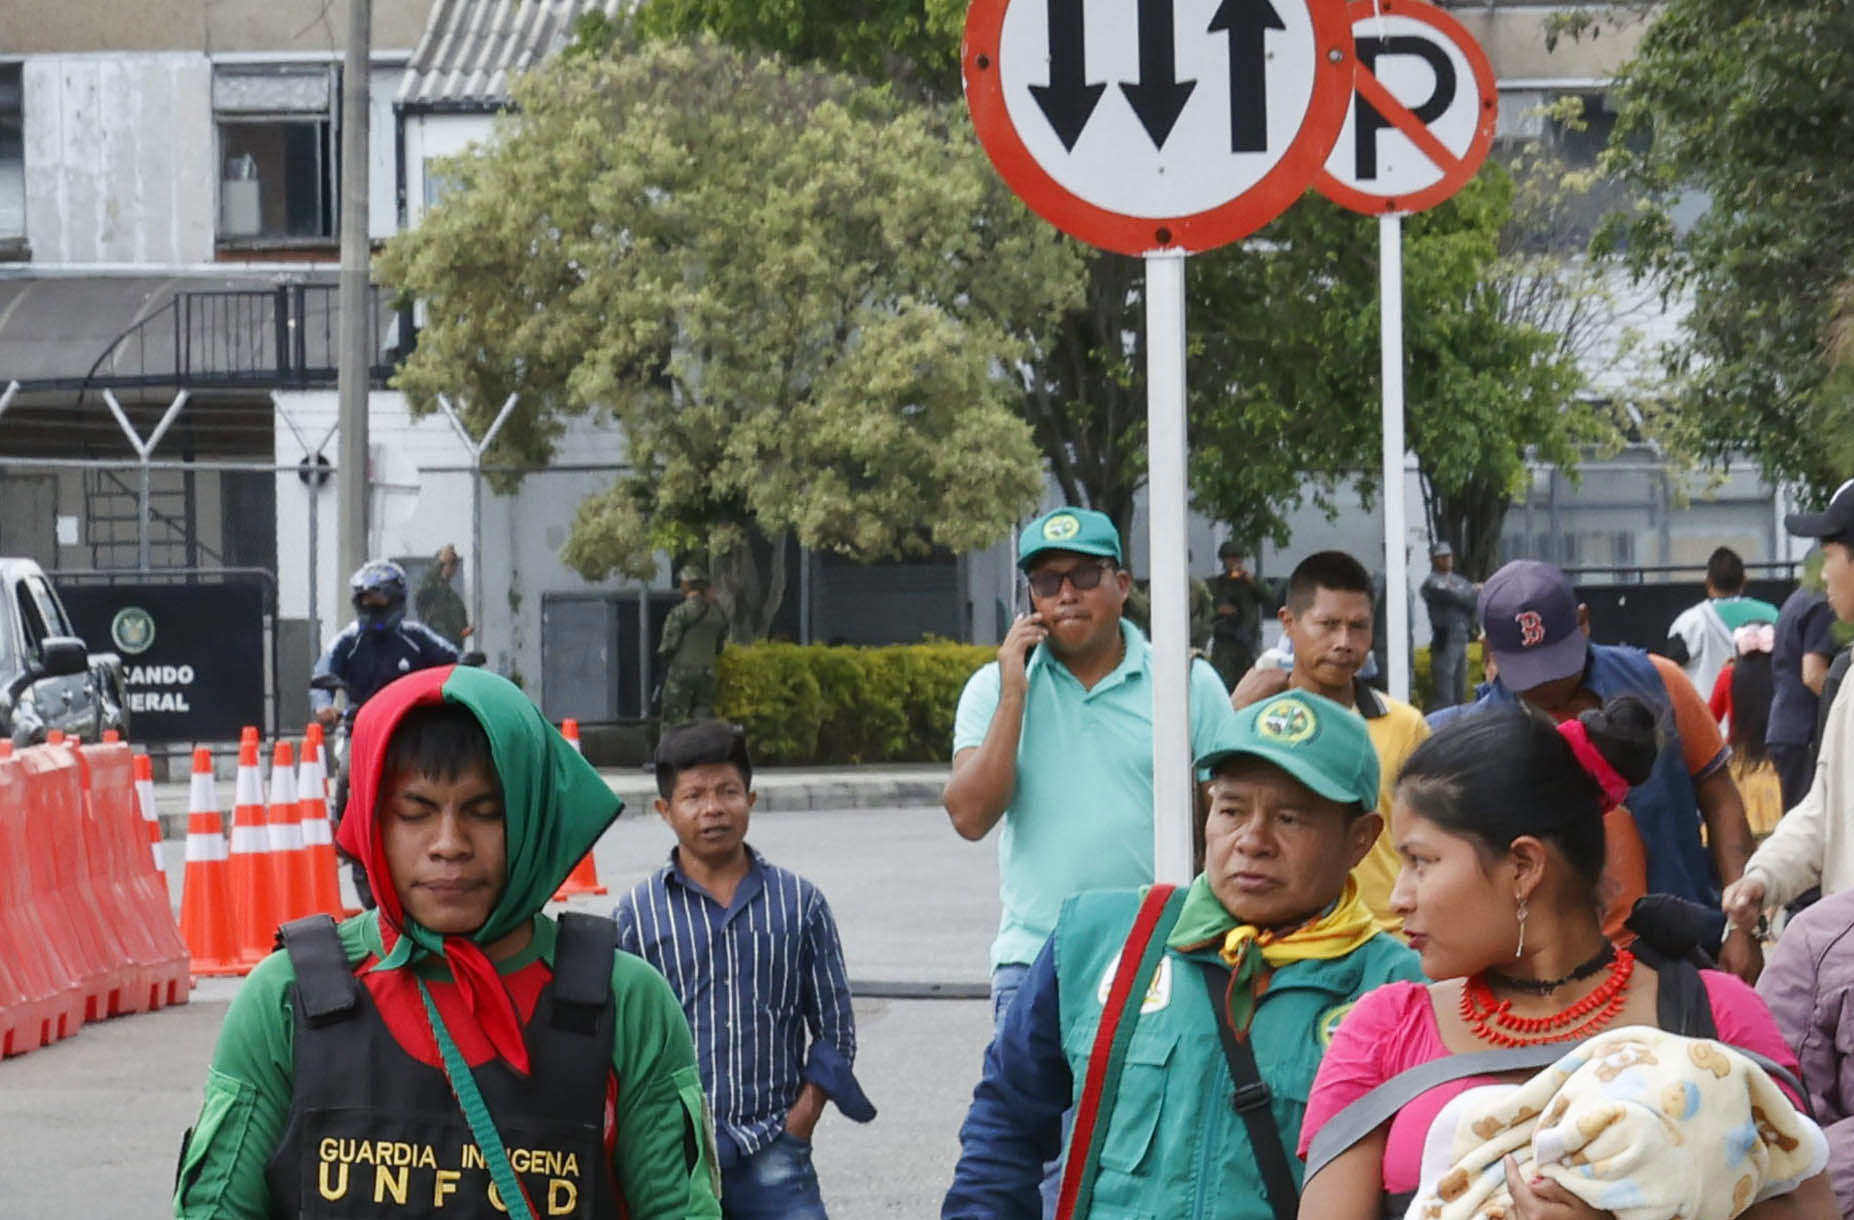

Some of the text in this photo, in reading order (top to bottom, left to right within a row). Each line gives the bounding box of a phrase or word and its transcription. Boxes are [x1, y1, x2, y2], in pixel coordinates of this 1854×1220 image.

[1354, 35, 1457, 181] P
[1515, 611, 1545, 646] B
[123, 665, 194, 685] ANDO
[126, 692, 190, 712] ERAL
[319, 1137, 580, 1177] GUARDIA INGENA
